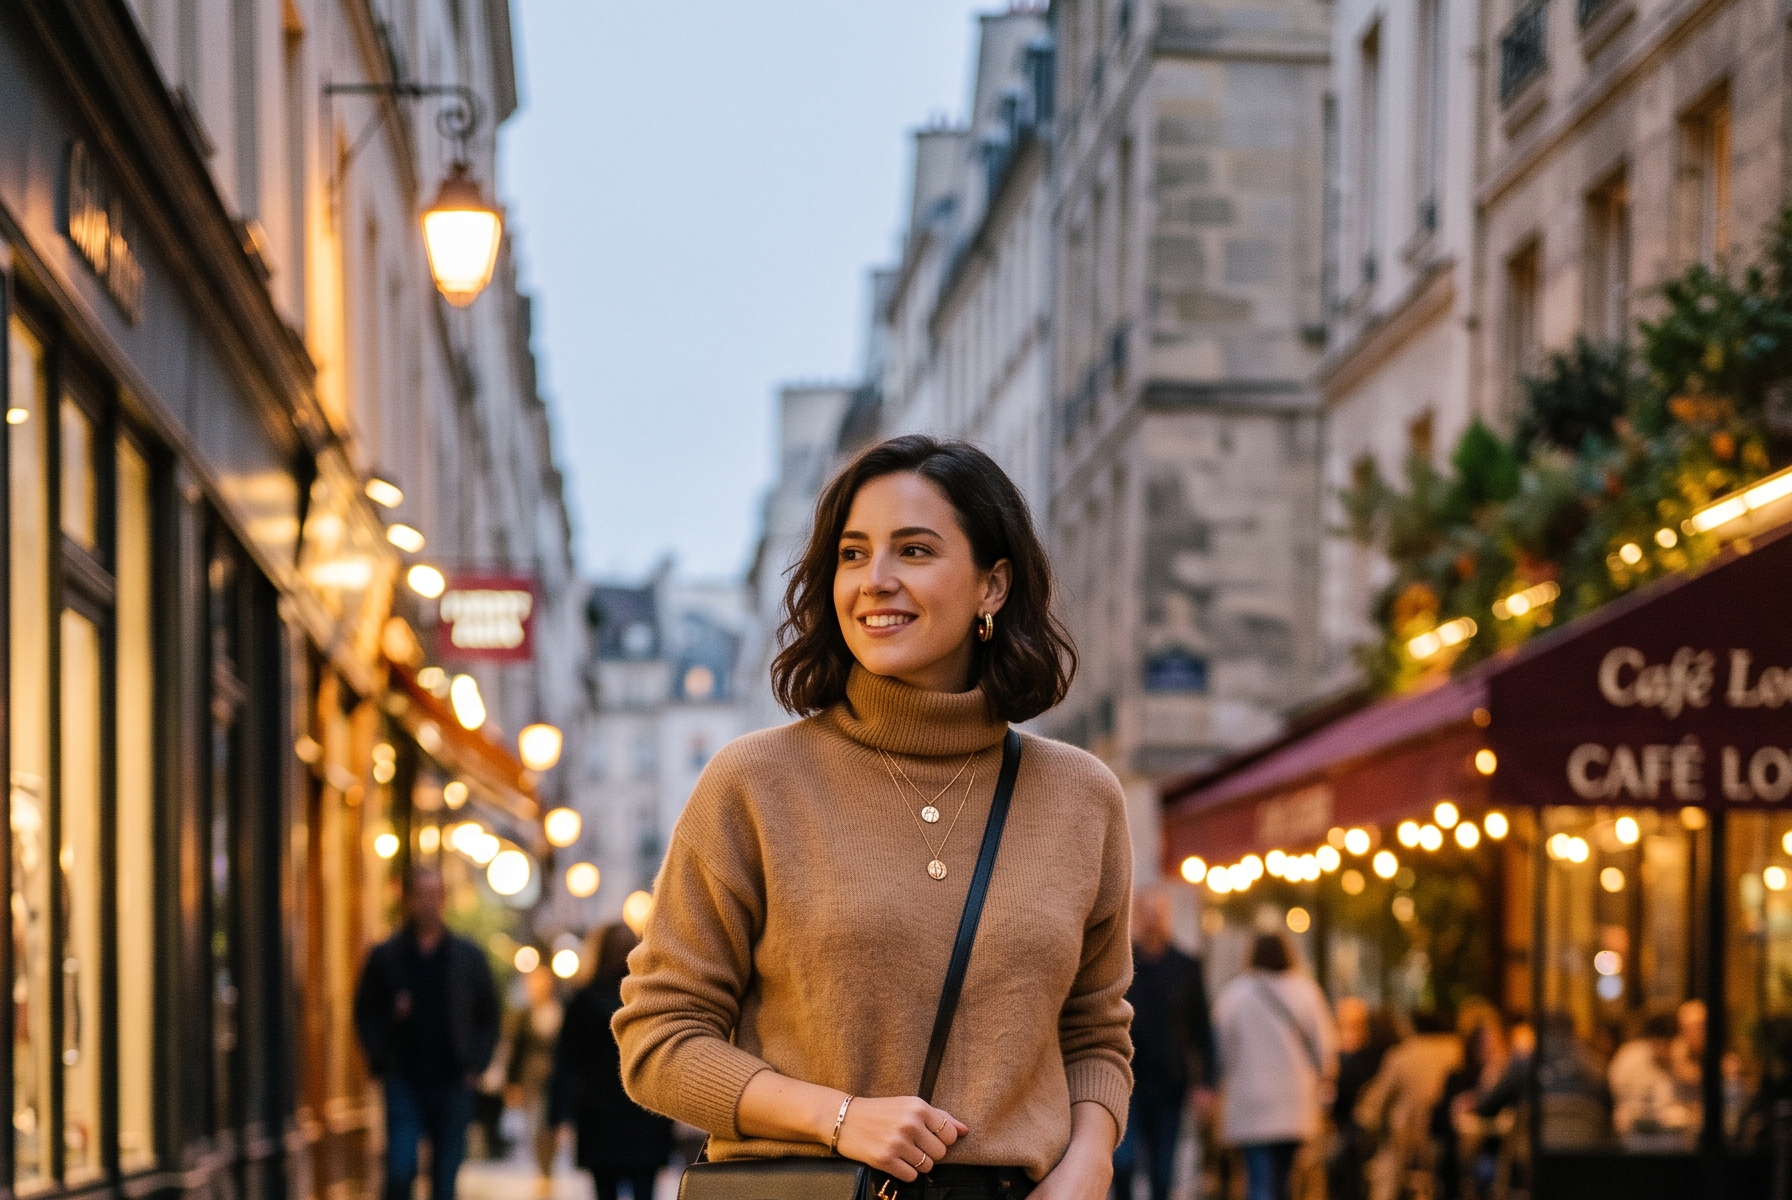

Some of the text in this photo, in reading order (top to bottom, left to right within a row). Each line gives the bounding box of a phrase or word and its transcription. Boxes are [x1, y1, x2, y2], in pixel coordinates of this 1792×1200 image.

[1598, 647, 1792, 719] Café Lo
[1567, 734, 1792, 800] CAFÉ LO
